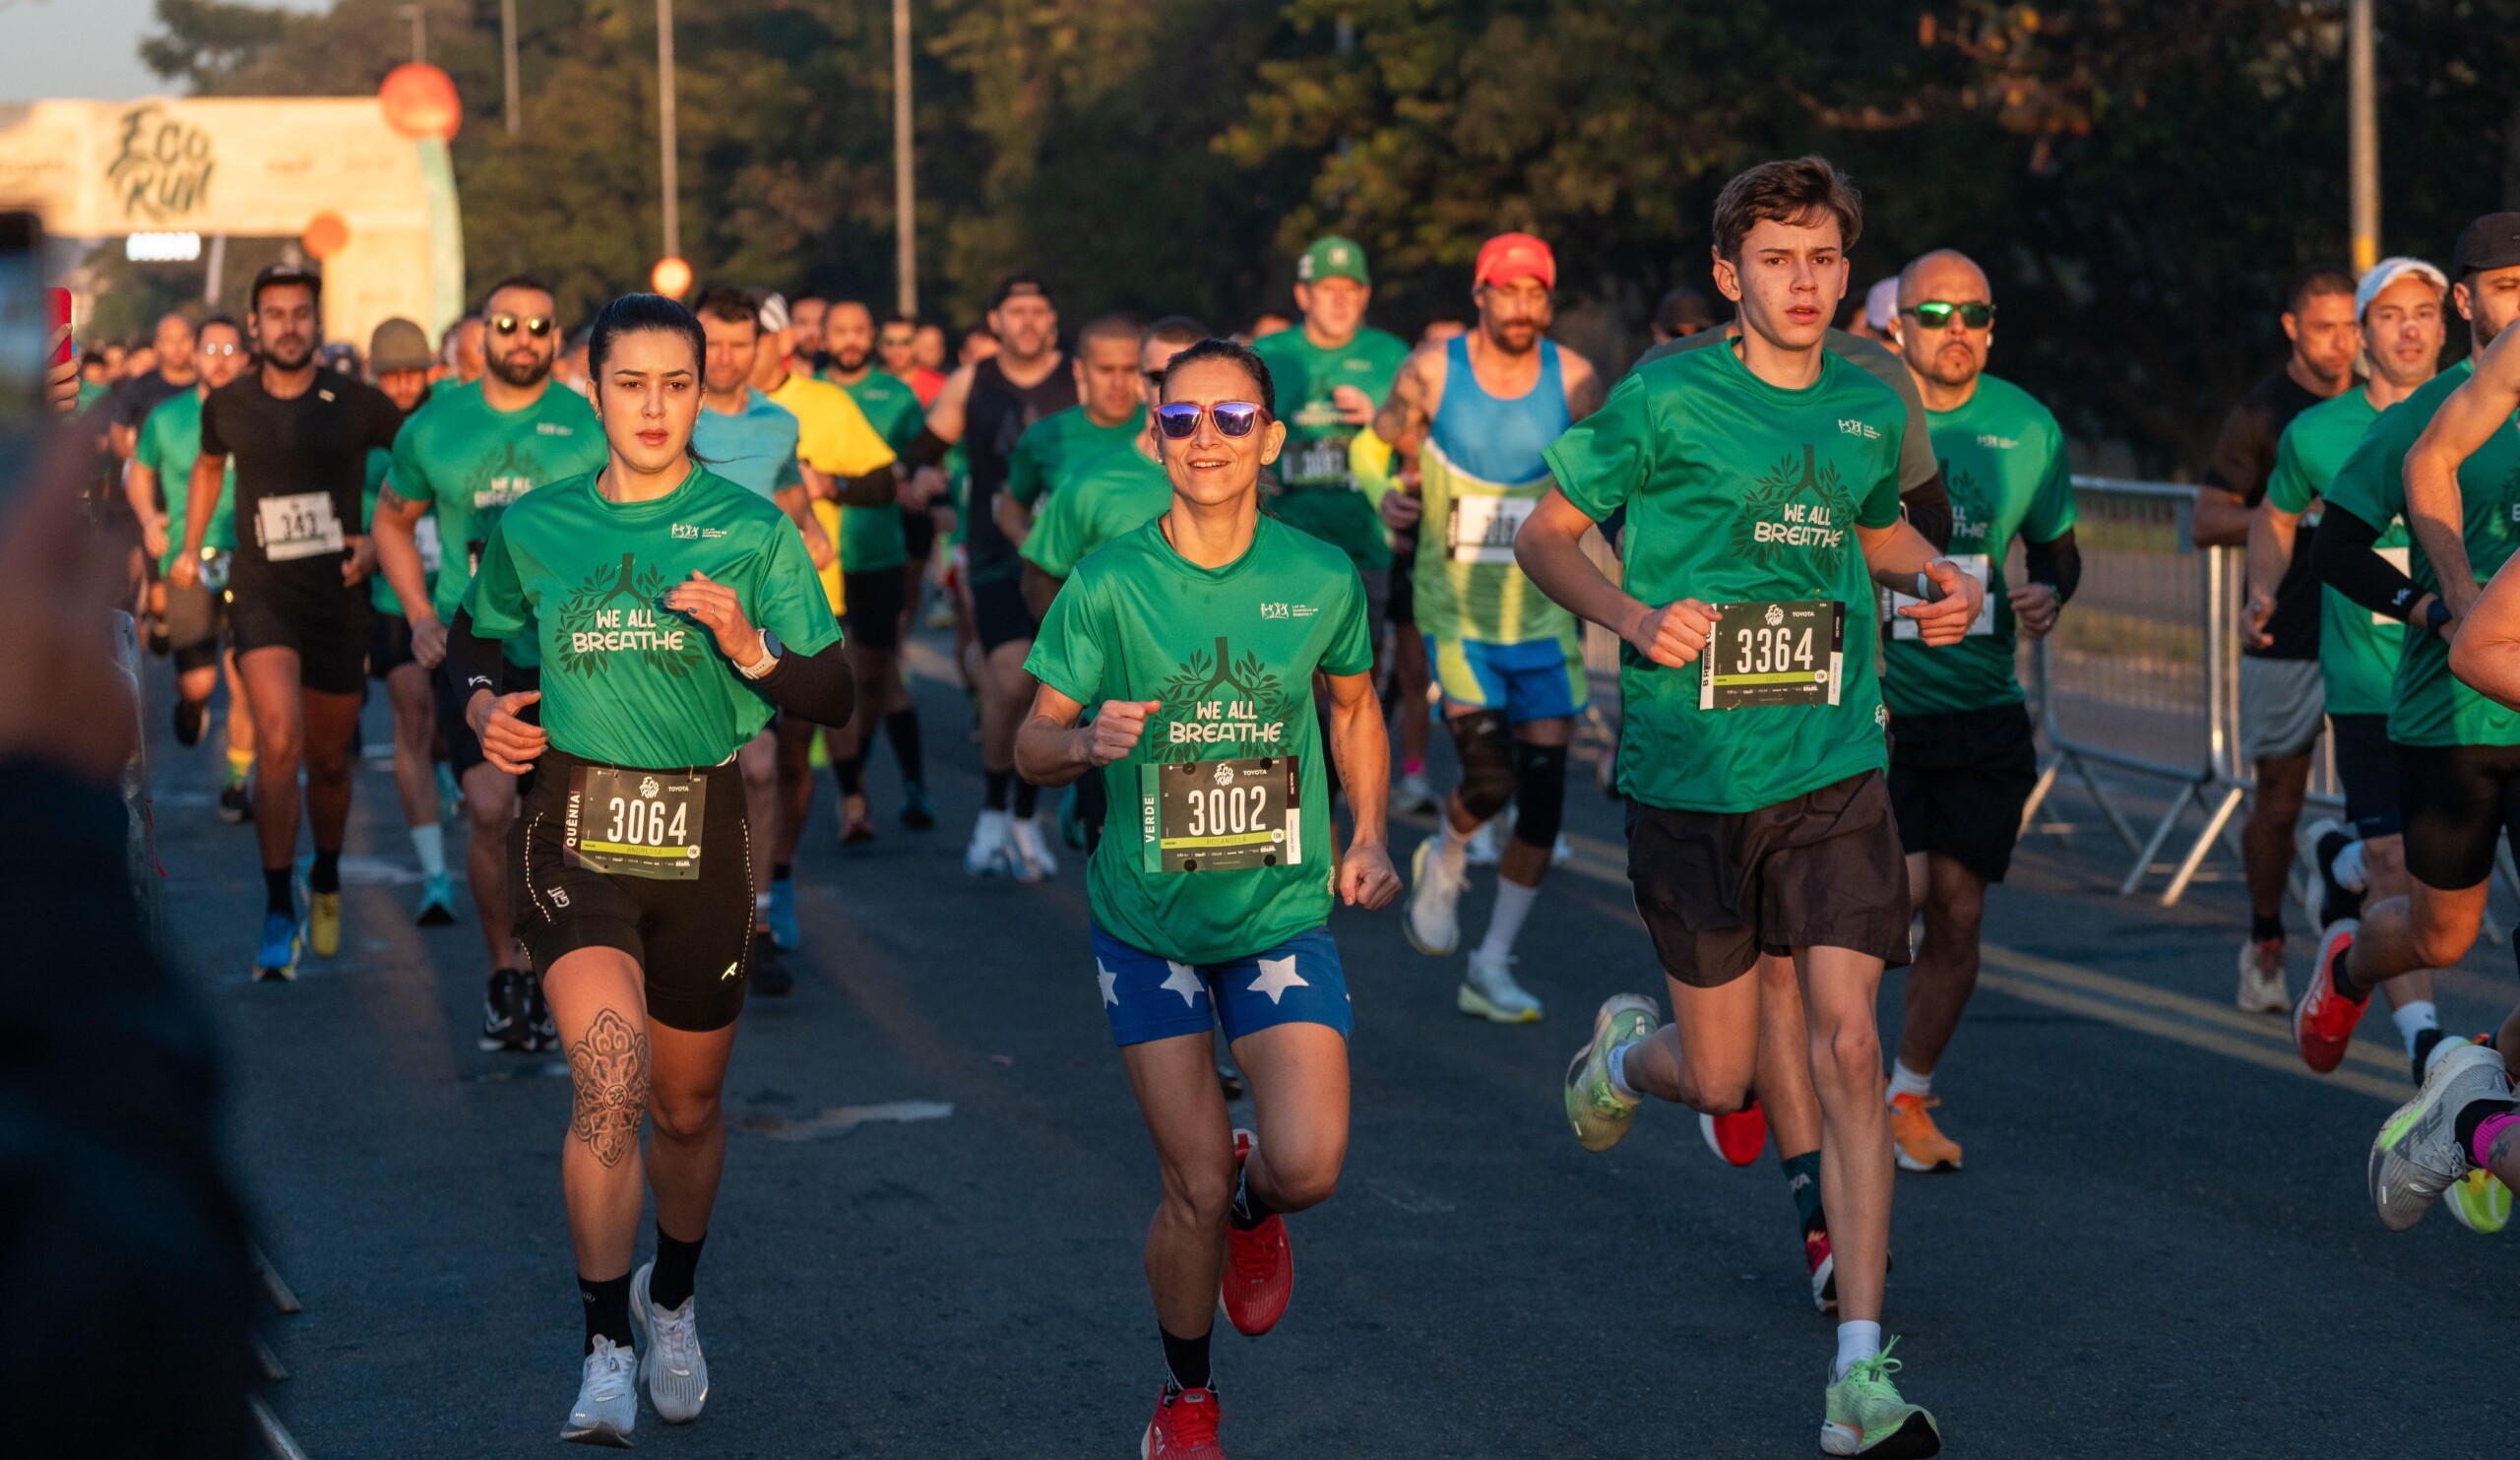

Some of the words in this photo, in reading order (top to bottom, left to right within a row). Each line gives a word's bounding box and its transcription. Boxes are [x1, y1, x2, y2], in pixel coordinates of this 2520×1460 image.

[1784, 503, 1805, 523] WE
[1808, 506, 1831, 526] ALL
[1754, 522, 1843, 548] BREATHE
[597, 609, 621, 629] WE
[628, 608, 657, 628] ALL
[572, 630, 685, 654] BREATHE
[1736, 627, 1813, 673] 3364
[1196, 700, 1223, 720] WE
[1228, 700, 1258, 720] ALL
[1169, 721, 1284, 743] BREATHE
[566, 794, 581, 847] QUÊNIA
[606, 796, 687, 846] 3064
[1144, 796, 1155, 843] VERDE
[1188, 786, 1267, 836] 3002
[626, 846, 662, 856] ANDRESSA
[1207, 836, 1247, 846] ROSANGELA
[547, 886, 570, 908] GRIT
